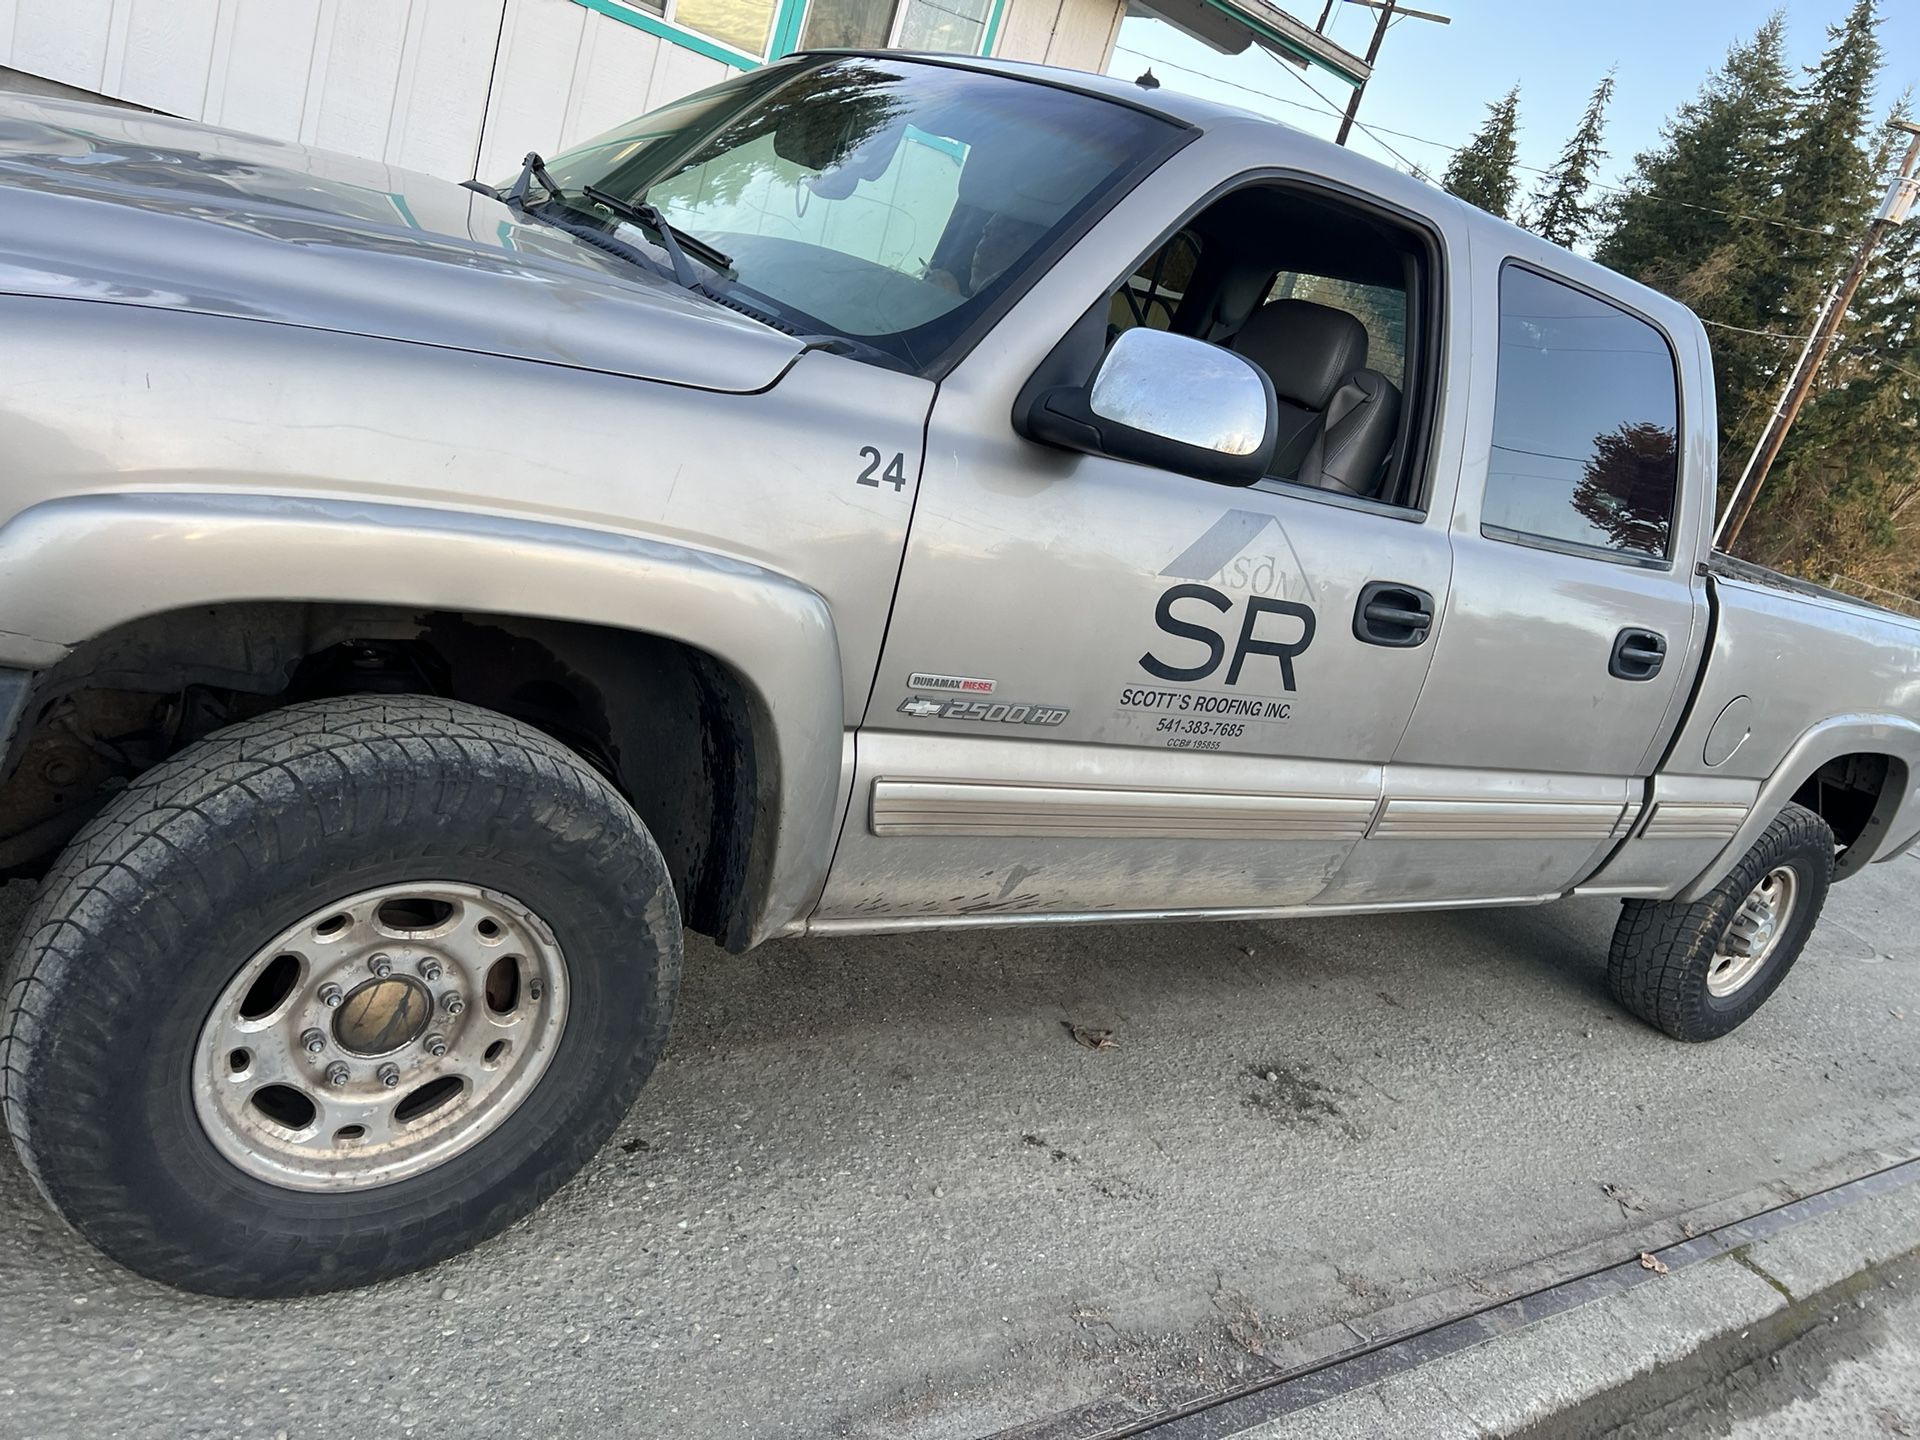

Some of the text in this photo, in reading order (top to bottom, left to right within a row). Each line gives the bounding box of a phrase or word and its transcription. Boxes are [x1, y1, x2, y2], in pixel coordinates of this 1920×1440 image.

[856, 446, 906, 492] 24
[1138, 583, 1317, 692] SR
[912, 676, 993, 692] DURAMAX DIESEL
[943, 700, 1068, 724] 2500 HD
[1119, 689, 1291, 719] SCOTT'S ROOFING INC.
[1156, 718, 1246, 738] 541-383-7685
[1166, 738, 1221, 750] CCB# 195855
